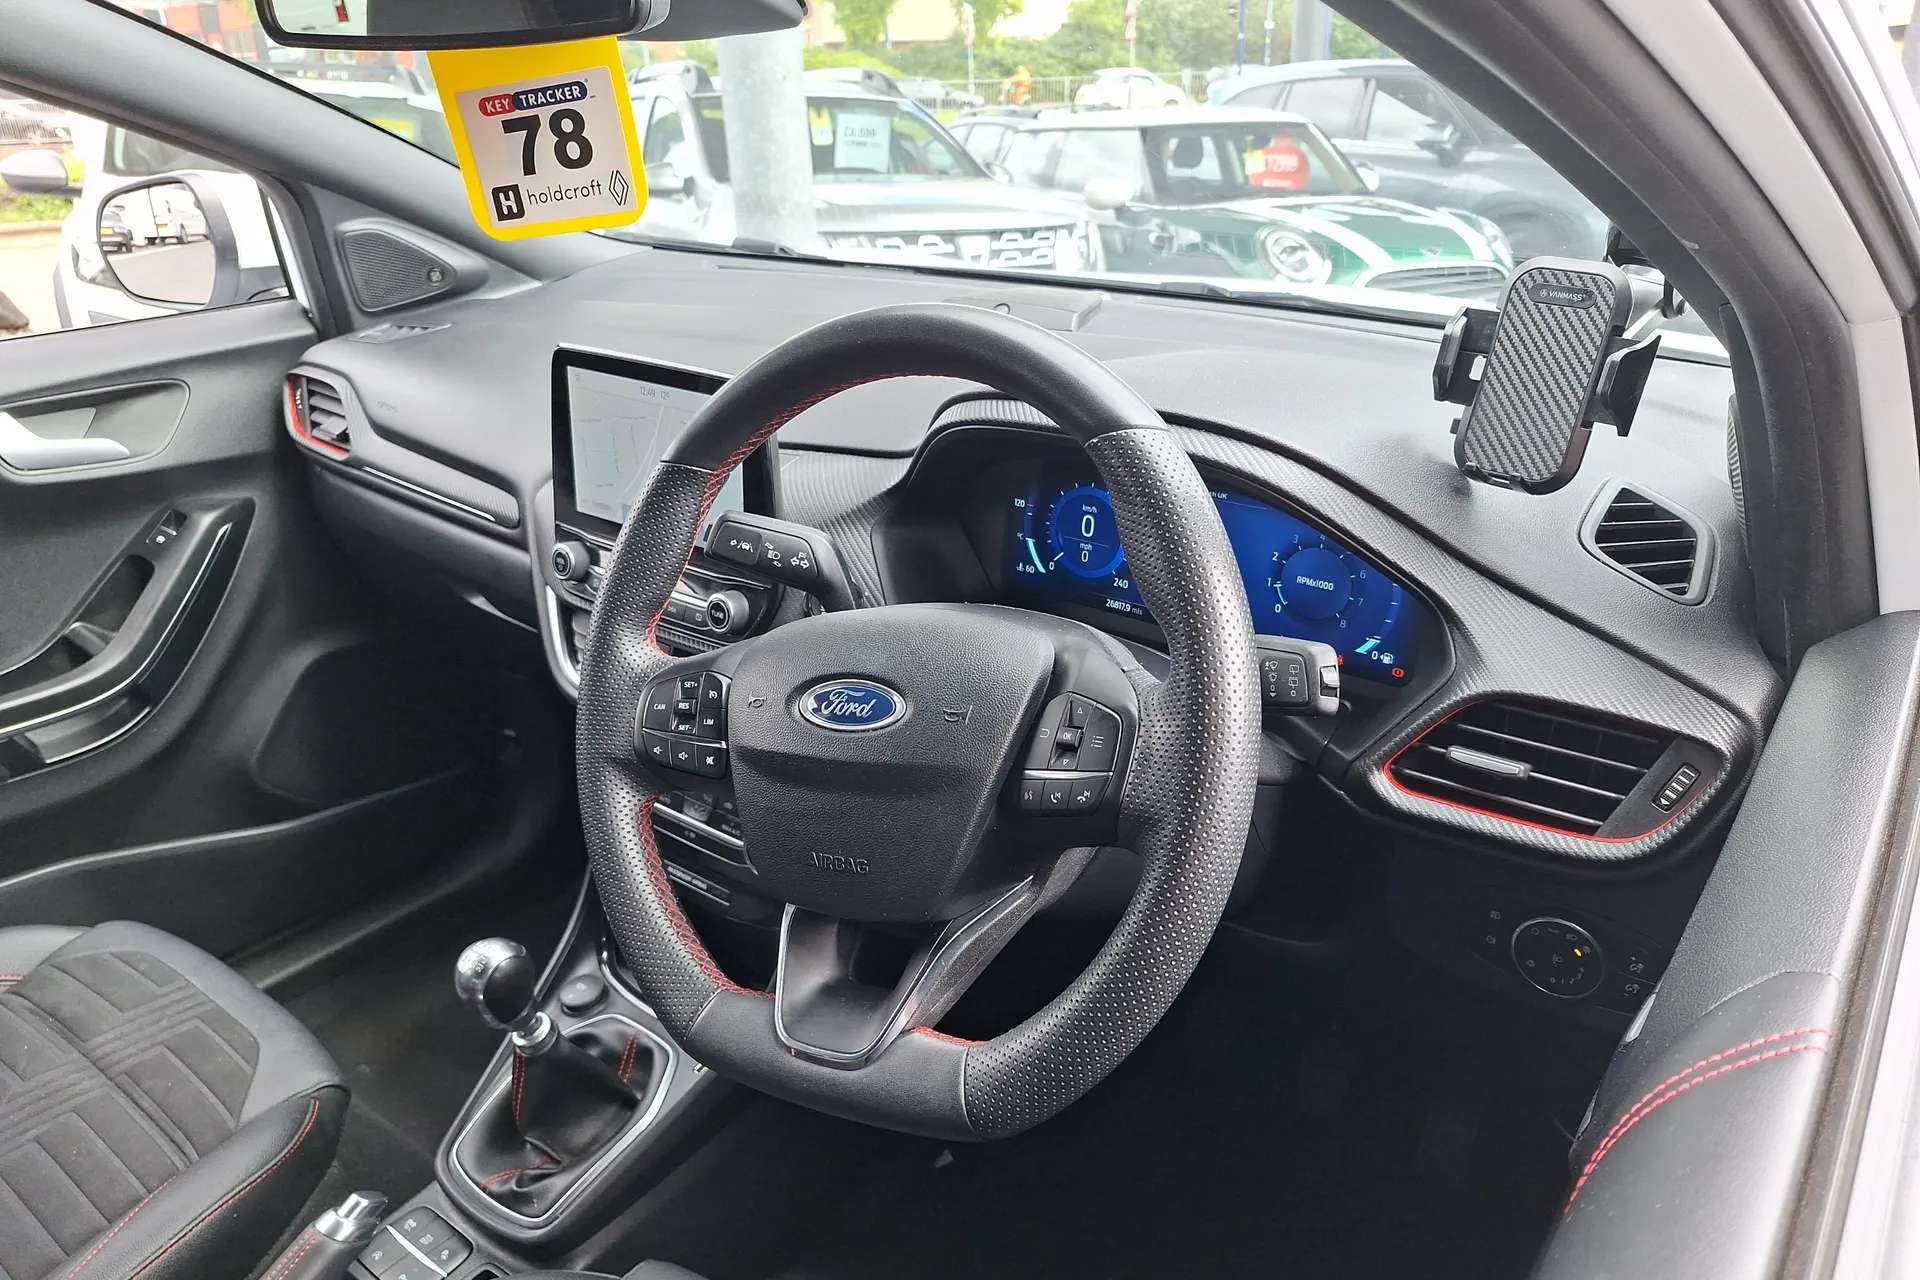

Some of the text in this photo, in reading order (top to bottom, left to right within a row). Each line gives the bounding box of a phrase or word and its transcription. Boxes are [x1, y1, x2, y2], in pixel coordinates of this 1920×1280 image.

[485, 85, 582, 113] KEY TRACKER
[500, 108, 594, 176] 78
[526, 179, 602, 206] holdcroft
[1549, 290, 1583, 301] VANMASS
[1014, 498, 1026, 508] 120
[1082, 503, 1098, 514] km/h
[1081, 514, 1095, 538] 0
[1079, 542, 1093, 552] mph
[1081, 550, 1089, 563] 0
[1271, 551, 1279, 561] 2
[1025, 563, 1035, 574] 60
[1048, 561, 1055, 571] 0
[1359, 570, 1367, 579] 6
[1112, 577, 1129, 589] 240
[1267, 577, 1271, 587] 1
[1296, 575, 1334, 591] RPMx1000
[1105, 598, 1131, 612] 26817.9
[1274, 604, 1281, 613] 0
[1339, 619, 1346, 629] 8
[1371, 651, 1378, 660] 0
[821, 688, 875, 718] Ford
[1062, 732, 1073, 741] OK
[810, 851, 870, 874] AIRBAG
